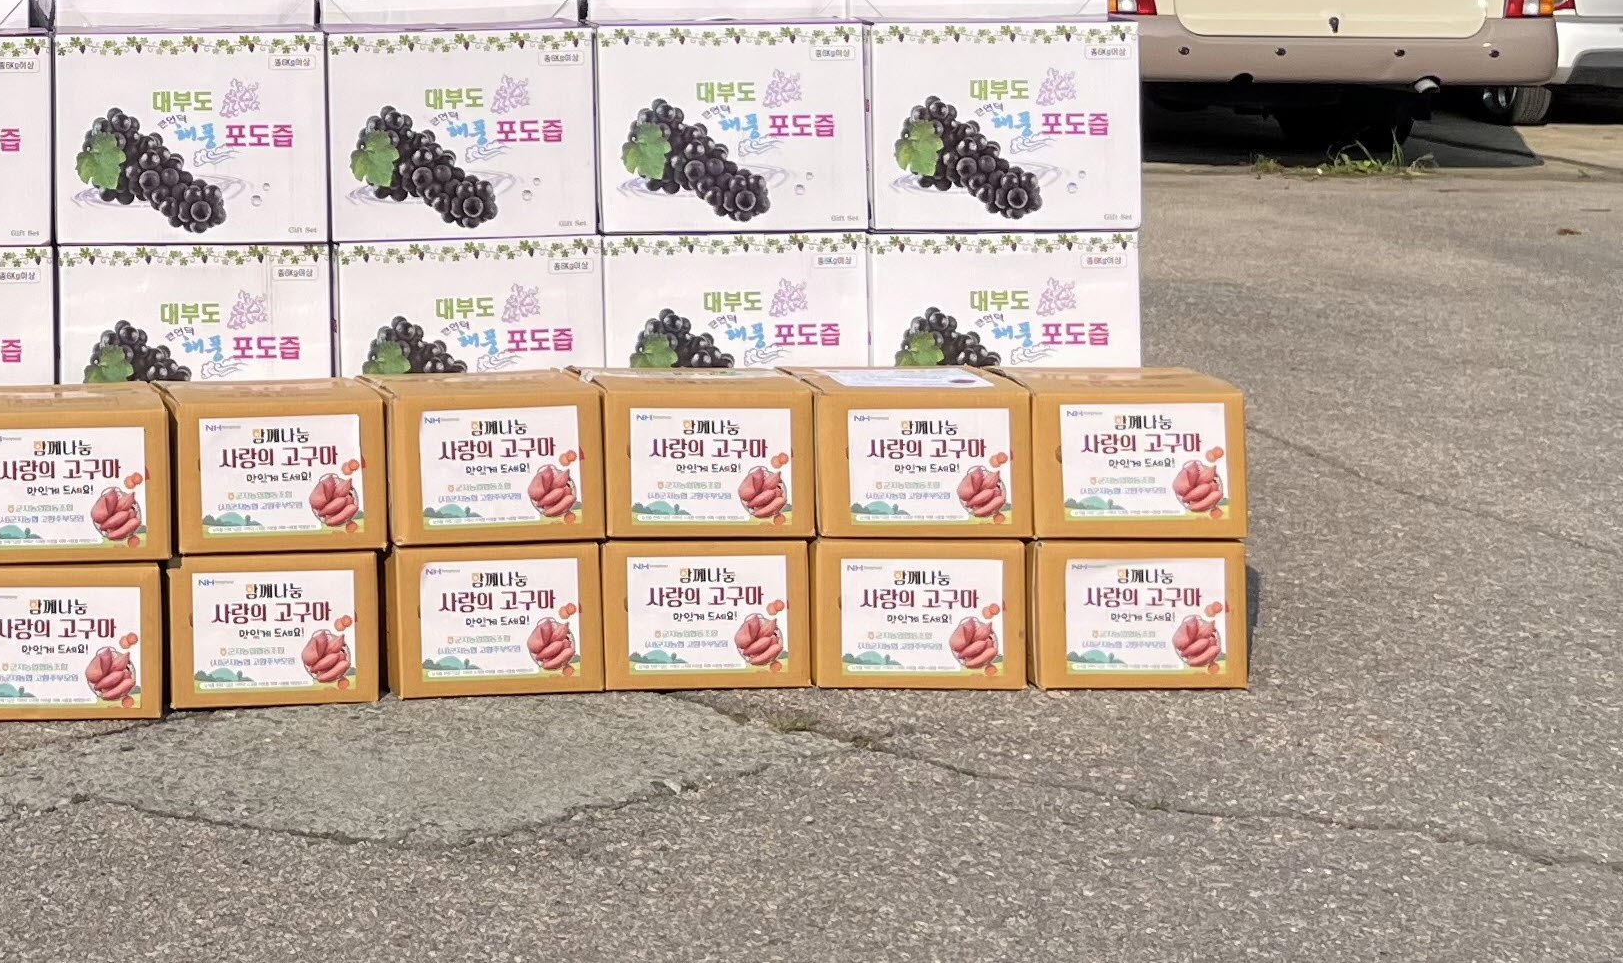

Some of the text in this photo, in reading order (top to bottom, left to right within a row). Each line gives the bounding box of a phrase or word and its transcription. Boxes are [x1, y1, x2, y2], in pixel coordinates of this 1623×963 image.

[425, 88, 483, 109] 대부도
[696, 82, 755, 102] 대부도
[970, 80, 1029, 99] 대부도
[153, 91, 212, 111] 대부도
[497, 119, 562, 143] 포도즙
[769, 114, 835, 137] 포도즙
[1042, 113, 1108, 135] 포도즙
[226, 124, 292, 147] 포도즙
[435, 297, 494, 319] 대부도
[704, 291, 761, 312] 대부도
[970, 290, 1029, 310] 대부도
[161, 303, 220, 324] 대부도
[507, 328, 573, 353] 포도즙
[775, 323, 840, 347] 포도즙
[1042, 323, 1108, 345] 포도즙
[233, 336, 300, 360] 포도즙
[252, 427, 310, 444] 함께나눔
[901, 420, 958, 435] 함께나눔
[438, 437, 557, 462] 사랑의 고구마
[649, 438, 769, 459] 사랑의 고구마
[867, 439, 987, 459] 사랑의 고구마
[1080, 433, 1203, 454] 사랑의 고구마
[219, 445, 339, 470] 사랑의 고구마
[0, 458, 122, 482] 사랑의 고구마
[894, 570, 951, 586] 함께나눔
[29, 599, 88, 615] 함께나눔
[439, 589, 556, 614] 사랑의 고구마
[646, 586, 764, 608] 사랑의 고구마
[860, 588, 980, 610] 사랑의 고구마
[1084, 587, 1202, 608] 사랑의 고구마
[211, 601, 332, 625] 사랑의 고구마
[58, 618, 117, 639] 고구마
